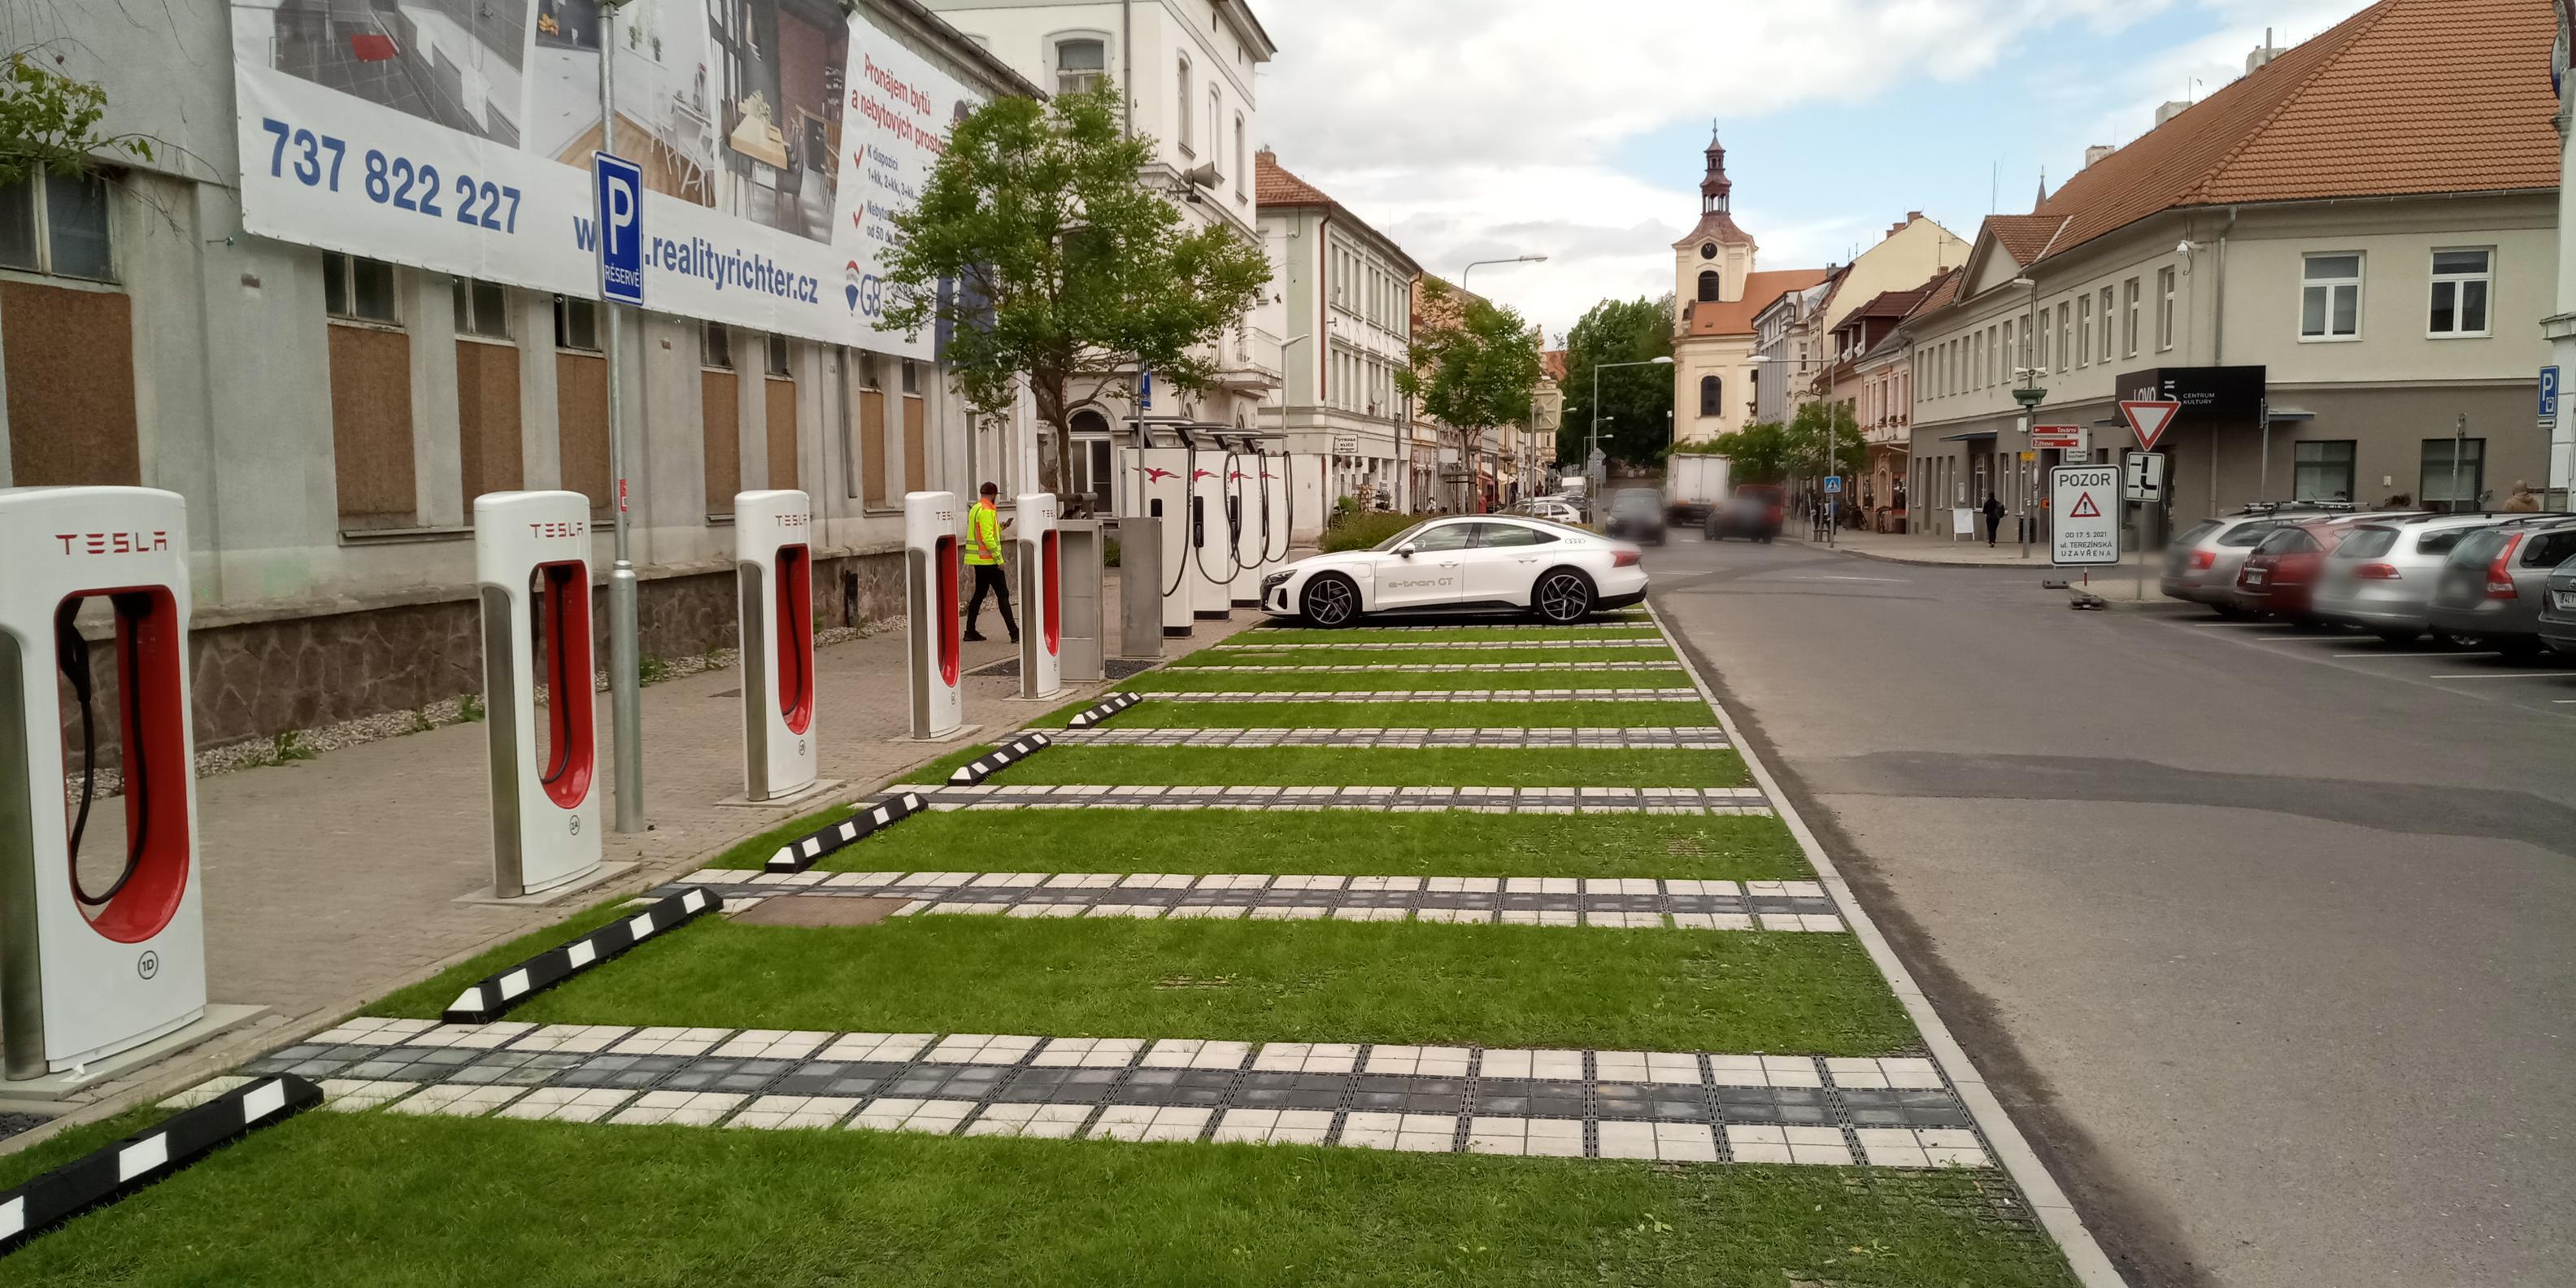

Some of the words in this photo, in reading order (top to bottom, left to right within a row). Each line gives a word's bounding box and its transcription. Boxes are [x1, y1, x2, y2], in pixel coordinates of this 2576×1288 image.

[864, 52, 908, 103] Pronájem
[910, 83, 931, 116] bytů
[851, 89, 859, 110] a
[860, 94, 912, 141] nebytových
[867, 143, 872, 159] K
[872, 147, 899, 171] dispozici
[263, 117, 346, 192] 737
[365, 150, 442, 218] 822
[456, 175, 521, 235] 227
[608, 176, 634, 255] P
[876, 225, 884, 241] 50
[573, 215, 818, 304] w.realityrichter.cz
[604, 263, 640, 288] RÉSERVÉ
[860, 273, 881, 318] G8
[2542, 372, 2554, 402] P
[2060, 472, 2111, 487] POZOR
[529, 522, 584, 538] TESLA
[54, 531, 168, 555] TESLA
[2061, 549, 2112, 557] UZAVŘENA
[2069, 540, 2113, 549] TEREZÍNSKÁ
[1438, 577, 1454, 586] GT
[141, 959, 154, 972] 1D
